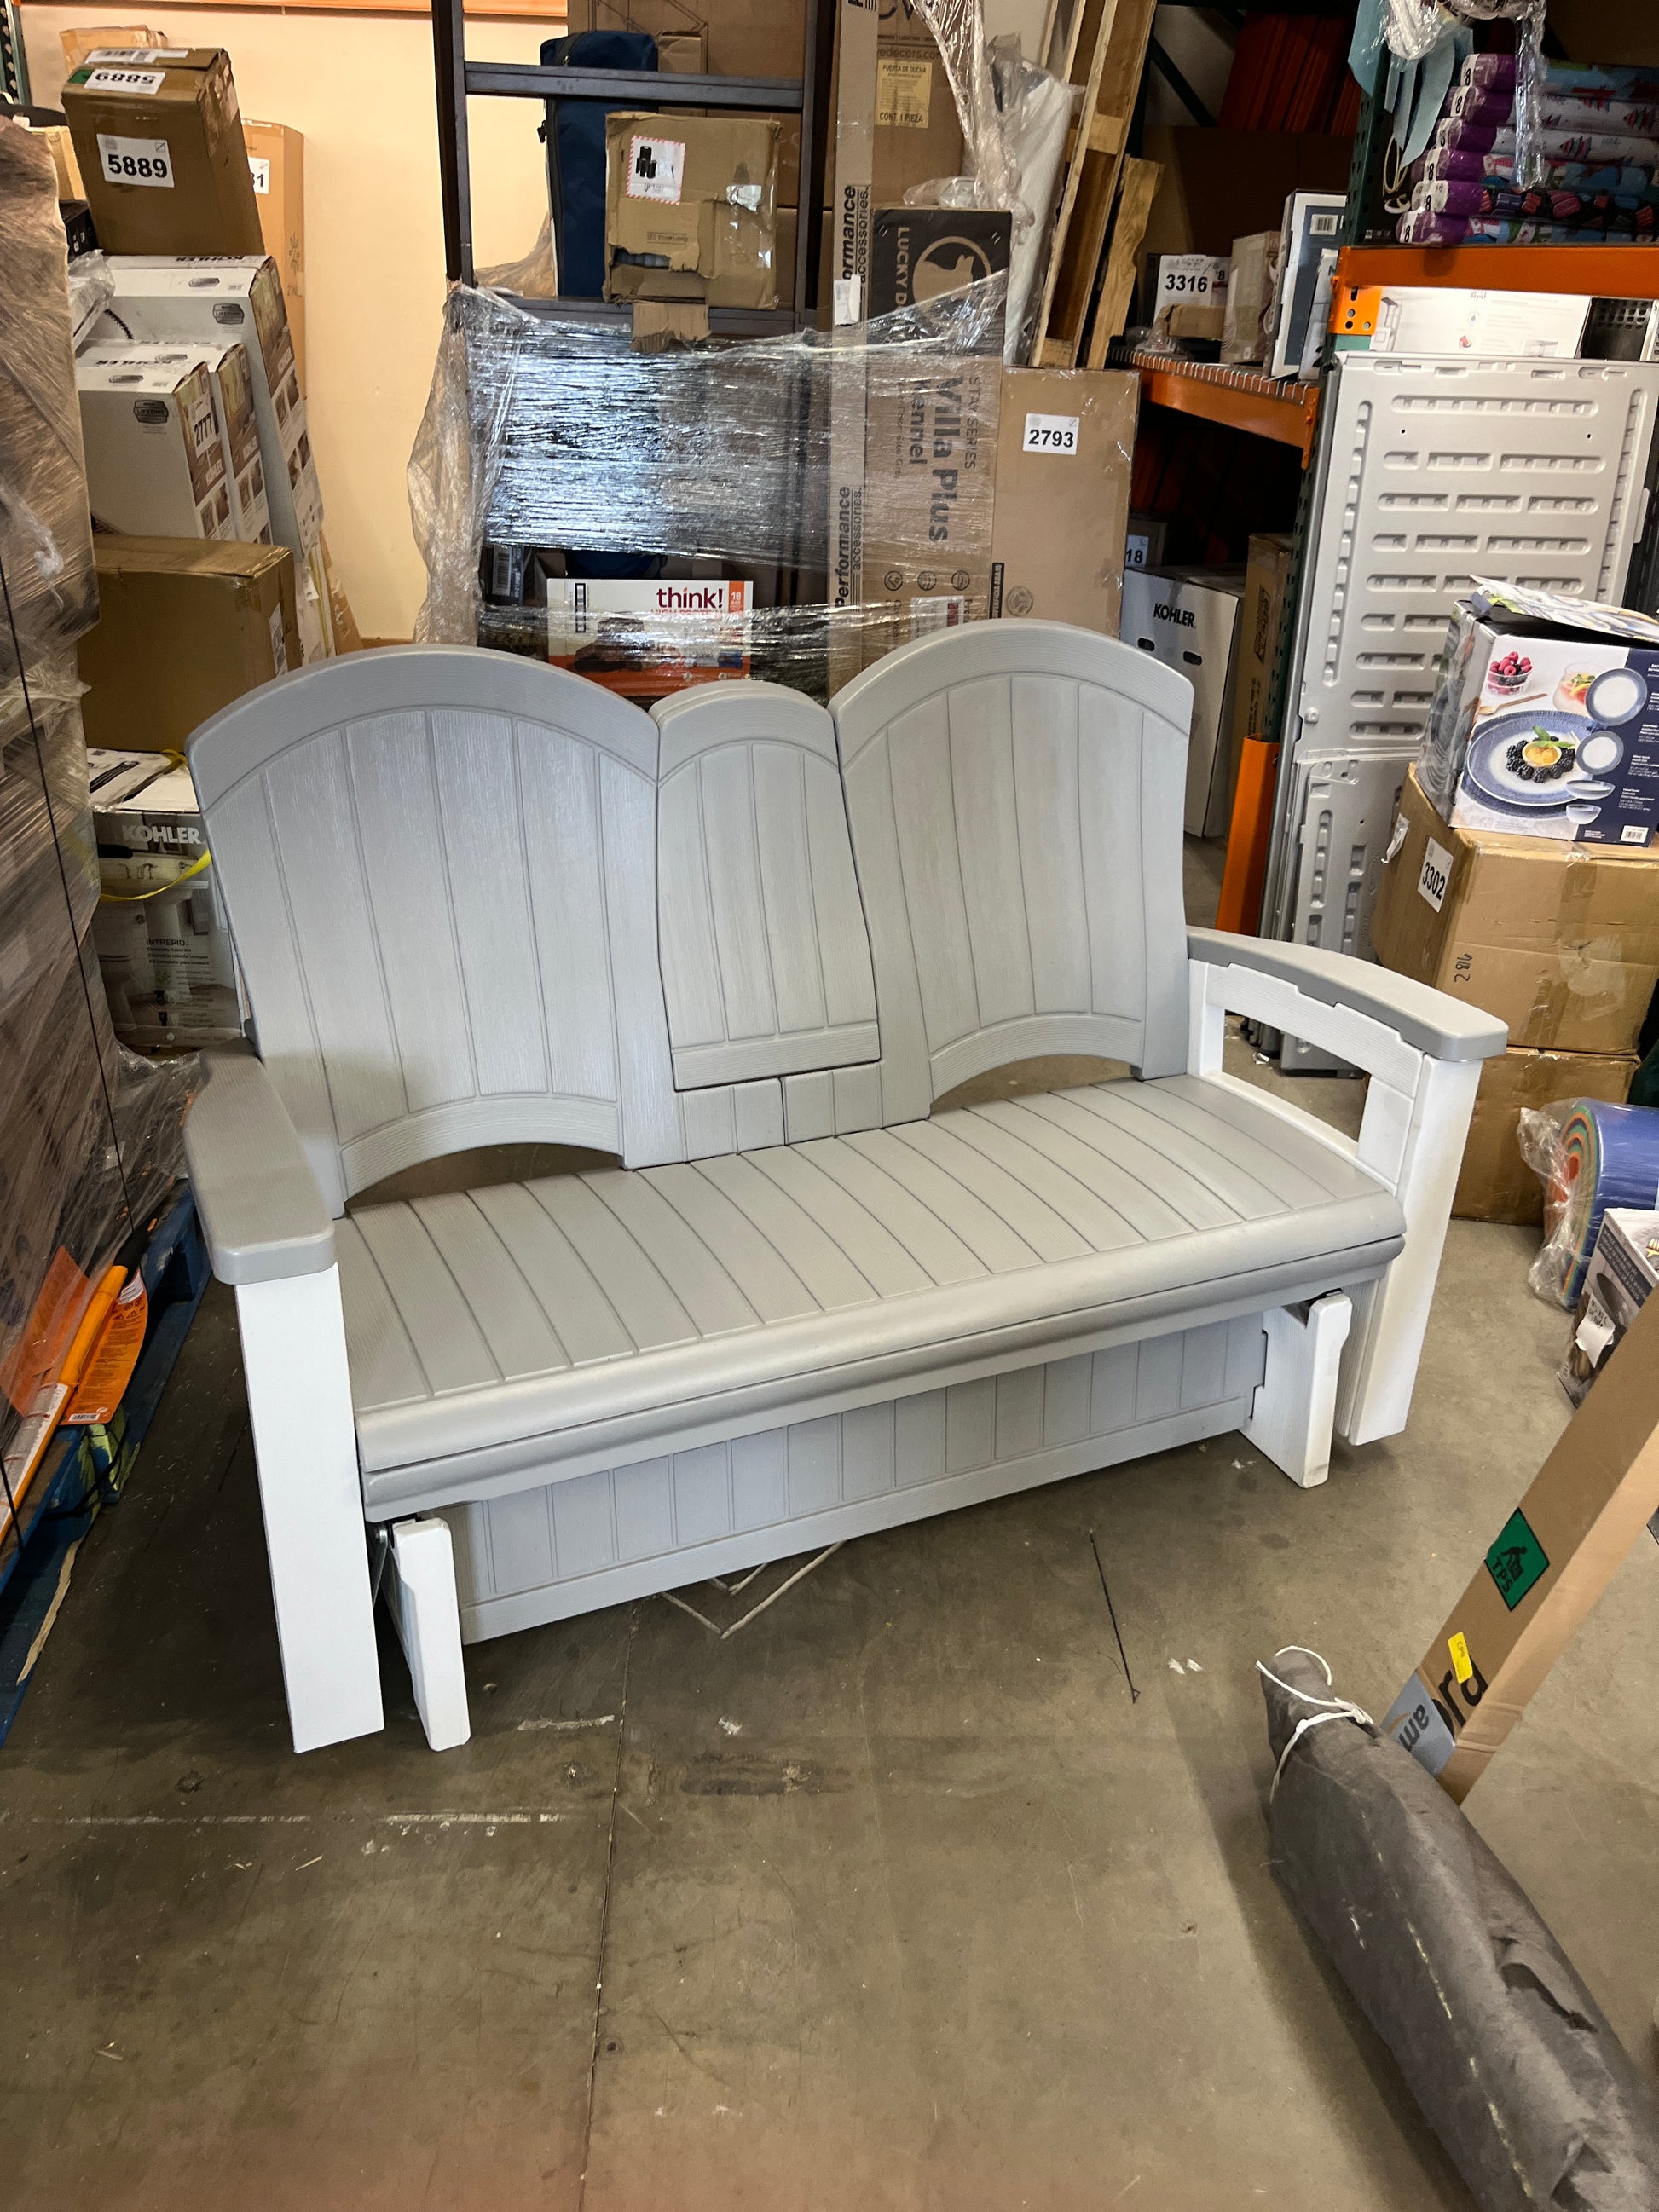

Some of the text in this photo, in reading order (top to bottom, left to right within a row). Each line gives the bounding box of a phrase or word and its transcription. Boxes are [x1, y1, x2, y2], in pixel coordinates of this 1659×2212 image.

[107, 153, 168, 178] 5889
[895, 226, 910, 287] LUCKY
[1165, 274, 1208, 292] 3316
[964, 418, 979, 470] SERIES
[1028, 429, 1074, 448] 2793
[928, 377, 963, 542] Villa Plus
[835, 486, 851, 608] Performance
[656, 587, 724, 609] think!
[1153, 603, 1196, 628] KOHLER
[122, 824, 202, 845] KOHLER
[1422, 861, 1446, 901] 3302
[147, 939, 186, 947] INTREPID
[1491, 1556, 1513, 1594] TPS
